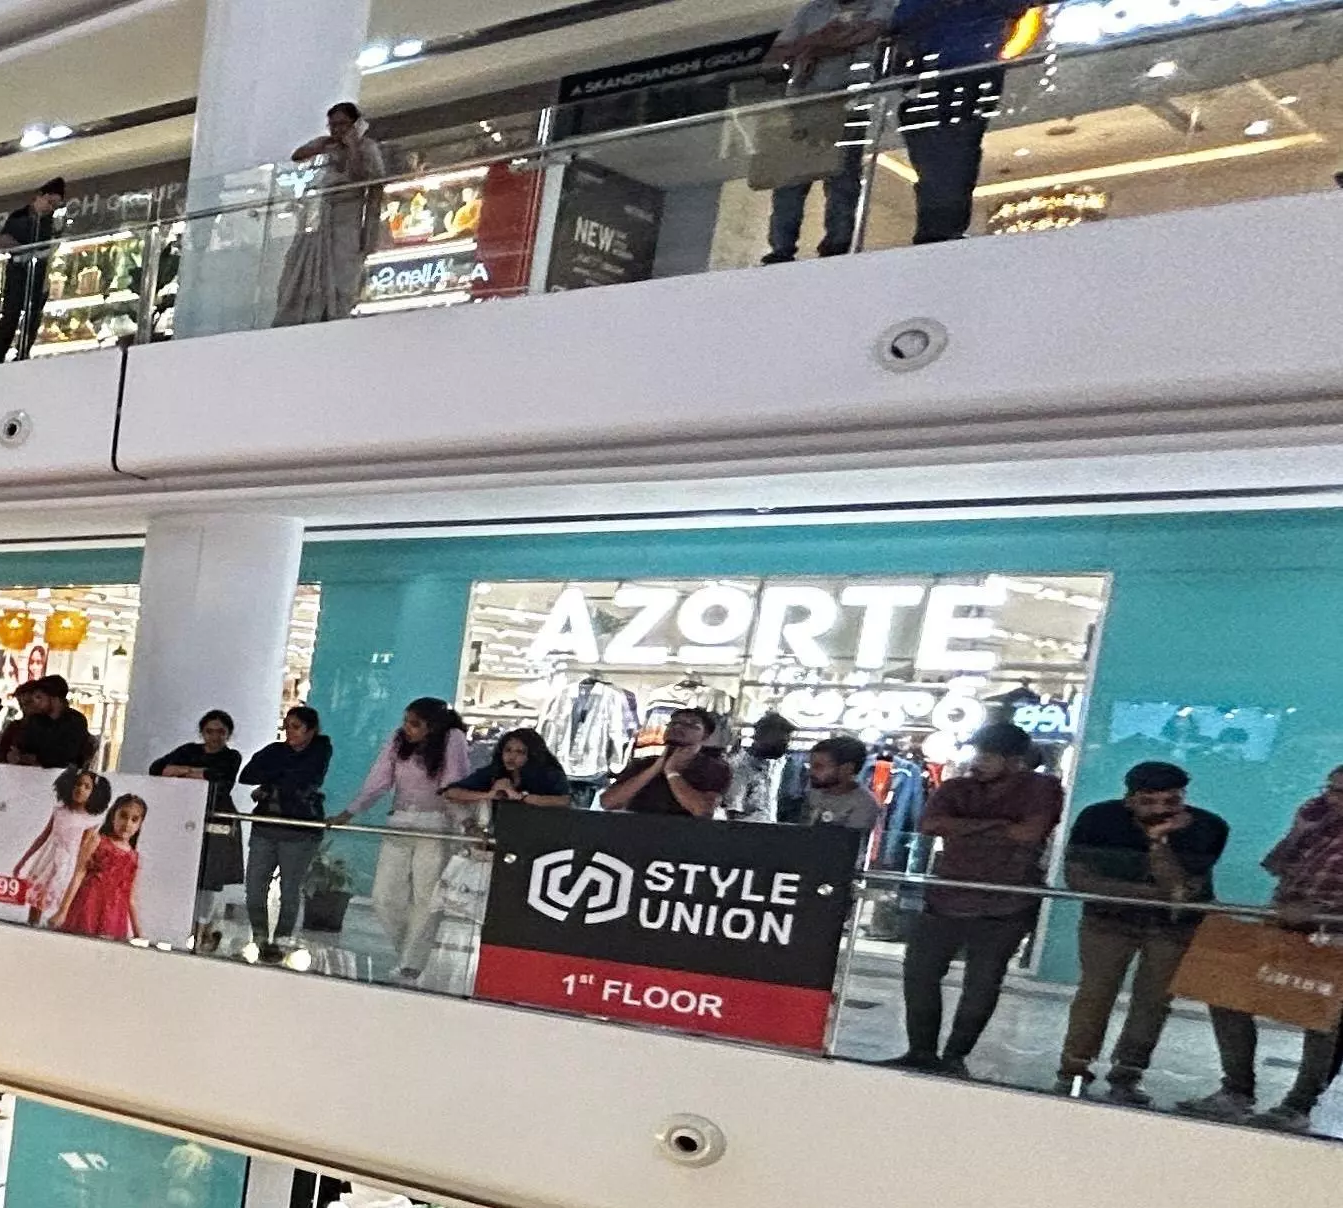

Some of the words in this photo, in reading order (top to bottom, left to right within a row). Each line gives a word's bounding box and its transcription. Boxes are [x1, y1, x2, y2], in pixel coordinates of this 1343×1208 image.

[575, 216, 615, 253] NEW
[530, 580, 1005, 672] AZORTE
[644, 860, 802, 906] STYLE
[638, 898, 794, 945] UNION
[562, 974, 595, 997] 1st
[602, 980, 723, 1019] FLOOR
